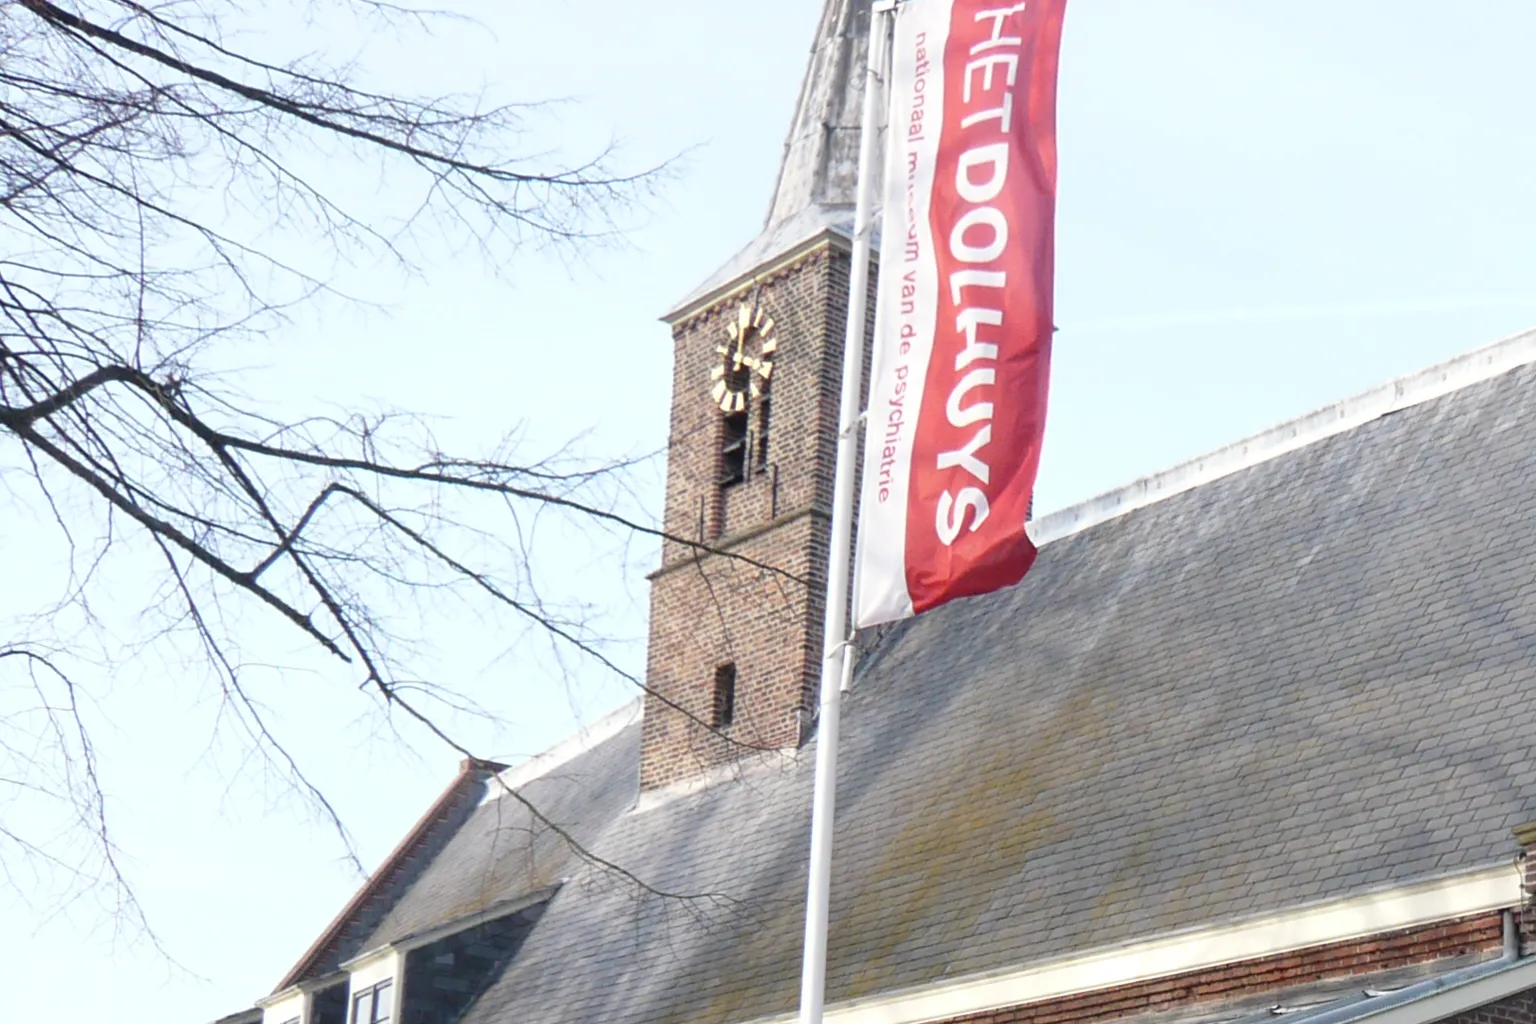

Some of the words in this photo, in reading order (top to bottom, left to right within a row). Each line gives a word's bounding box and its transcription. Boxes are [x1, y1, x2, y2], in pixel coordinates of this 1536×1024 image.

[907, 32, 930, 143] nationaal
[961, 2, 1026, 133] HET
[904, 152, 920, 263] mum
[899, 325, 917, 356] de
[900, 270, 917, 314] van
[936, 142, 1010, 546] DOLHUYS
[878, 365, 909, 503] psychiatrie
